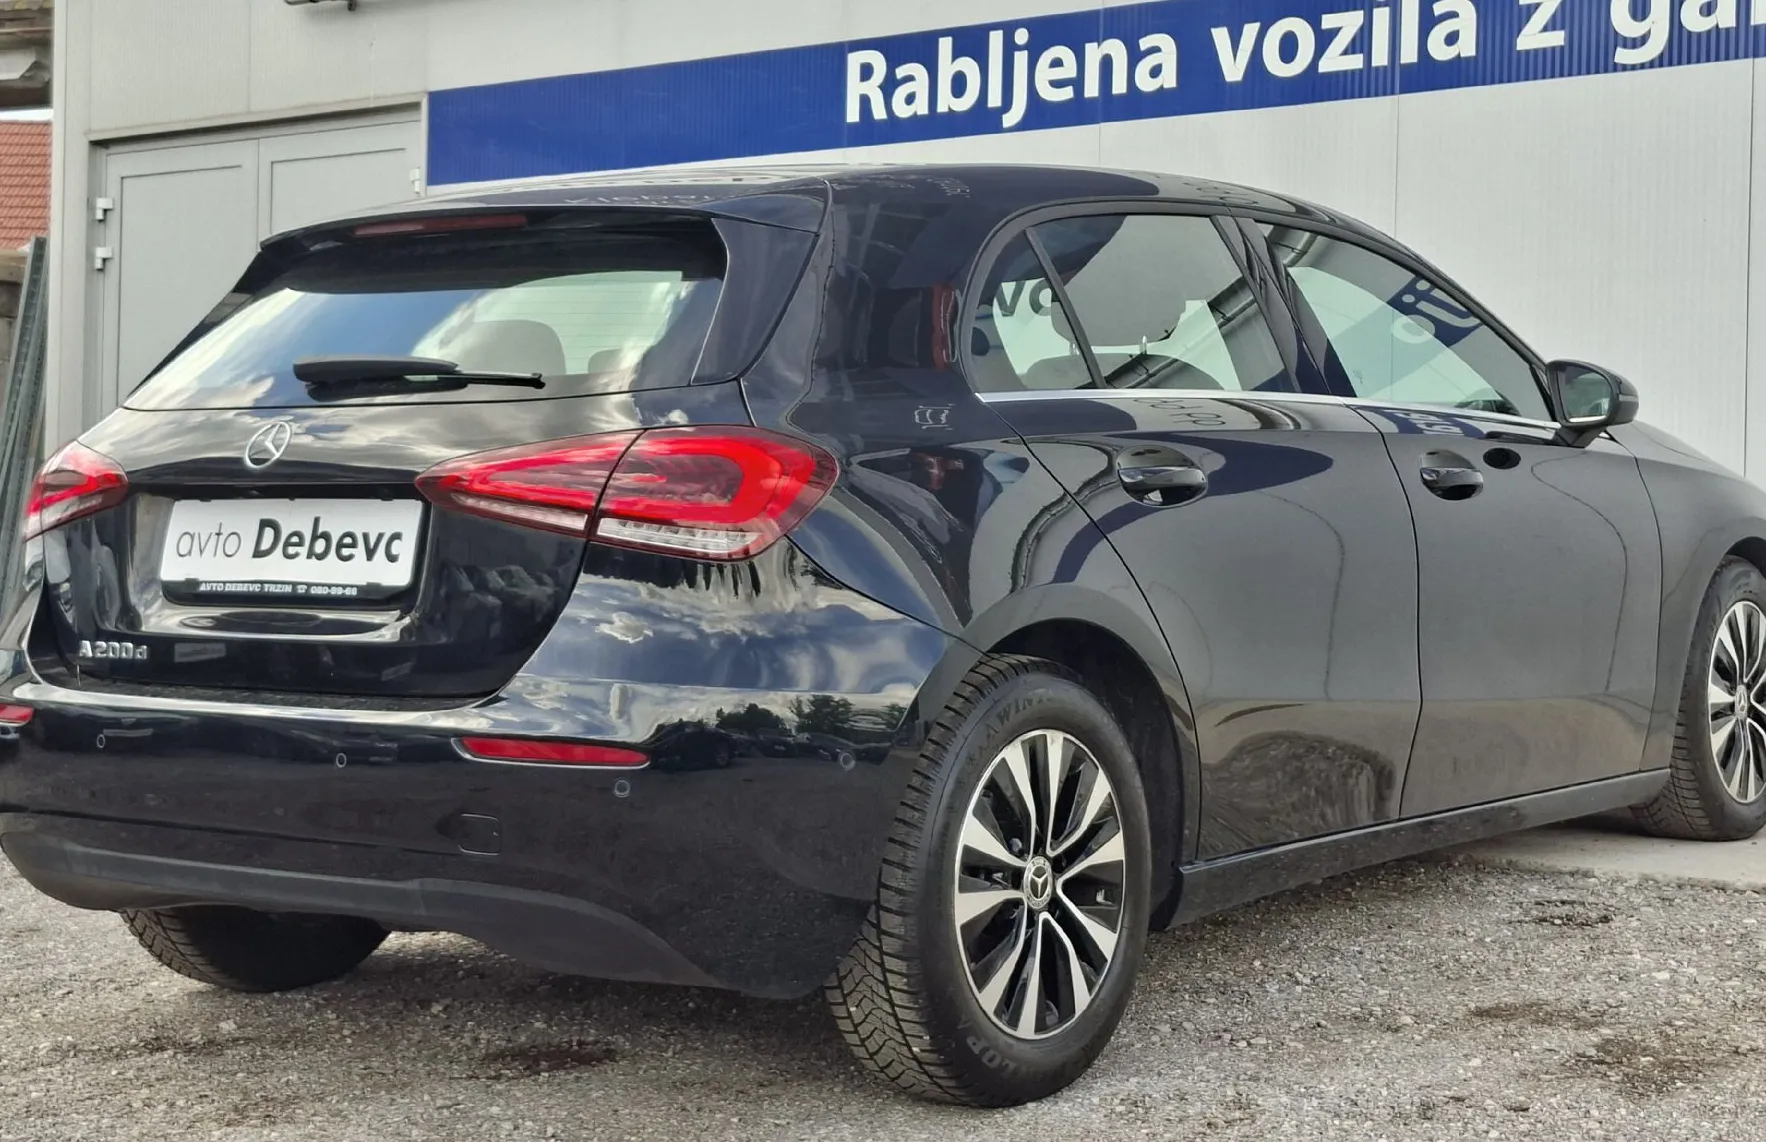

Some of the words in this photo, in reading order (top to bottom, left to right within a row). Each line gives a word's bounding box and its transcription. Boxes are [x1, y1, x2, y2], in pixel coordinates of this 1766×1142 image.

[845, 27, 1178, 129] Rabljena
[1210, 0, 1478, 84] vozila
[1515, 0, 1566, 51] z
[175, 521, 242, 559] avto
[251, 515, 404, 564] Debevc
[199, 582, 224, 593] AVTO
[224, 582, 261, 592] DEBEVC
